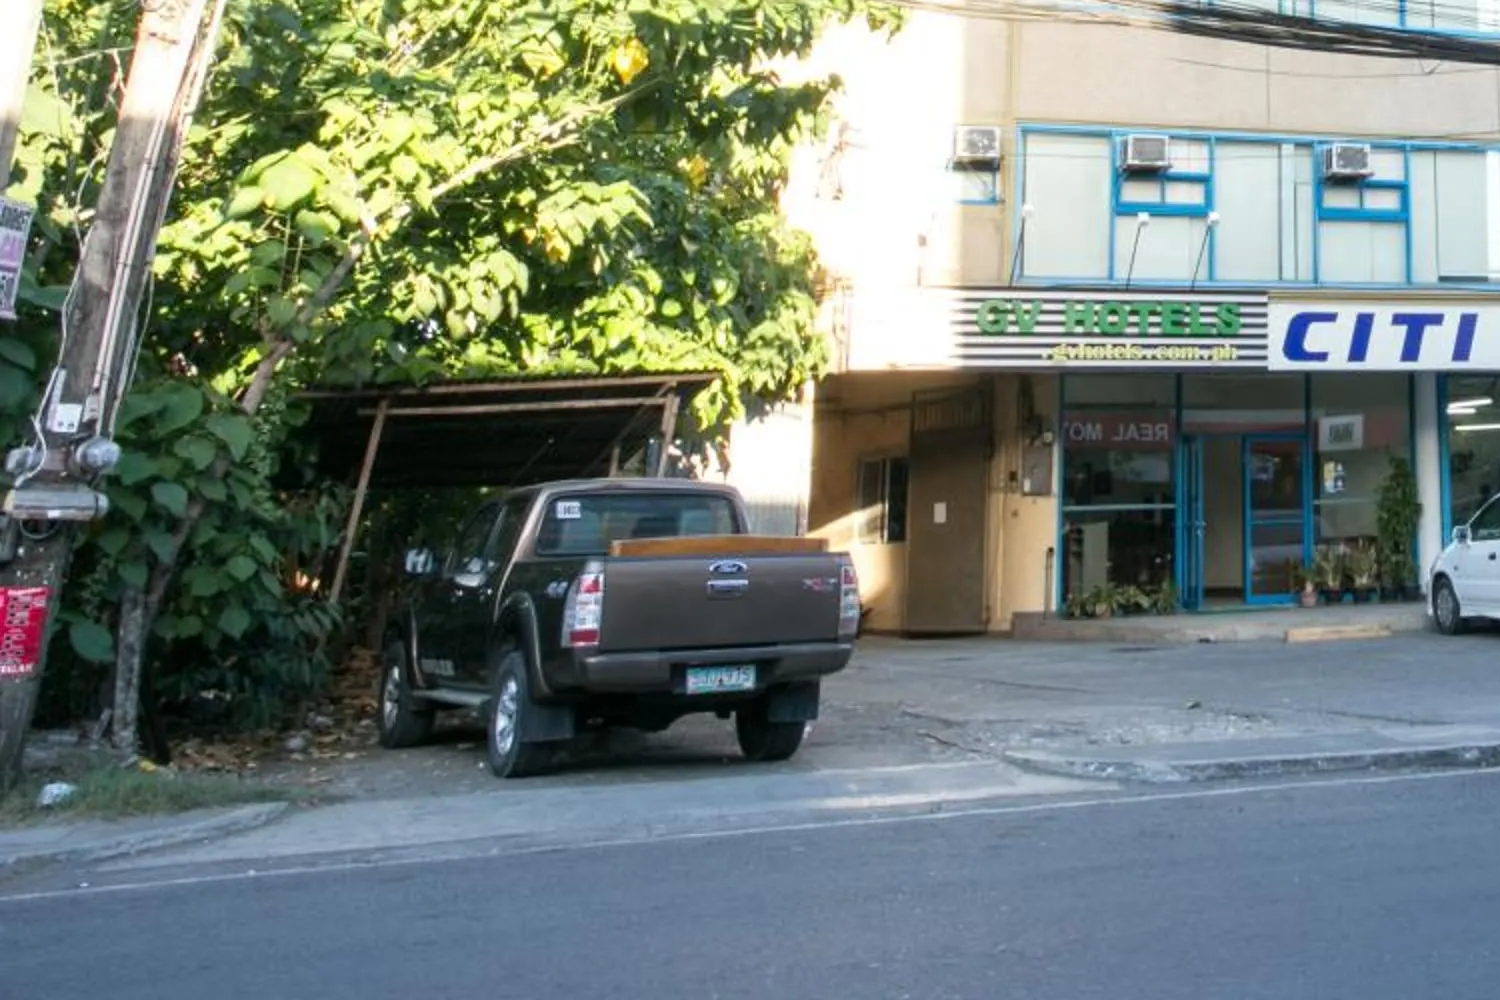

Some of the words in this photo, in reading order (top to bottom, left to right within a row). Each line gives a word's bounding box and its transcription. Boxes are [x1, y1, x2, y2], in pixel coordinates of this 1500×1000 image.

[975, 299, 1044, 336] GV
[1062, 300, 1243, 337] HOTELS
[1281, 311, 1479, 363] CITI
